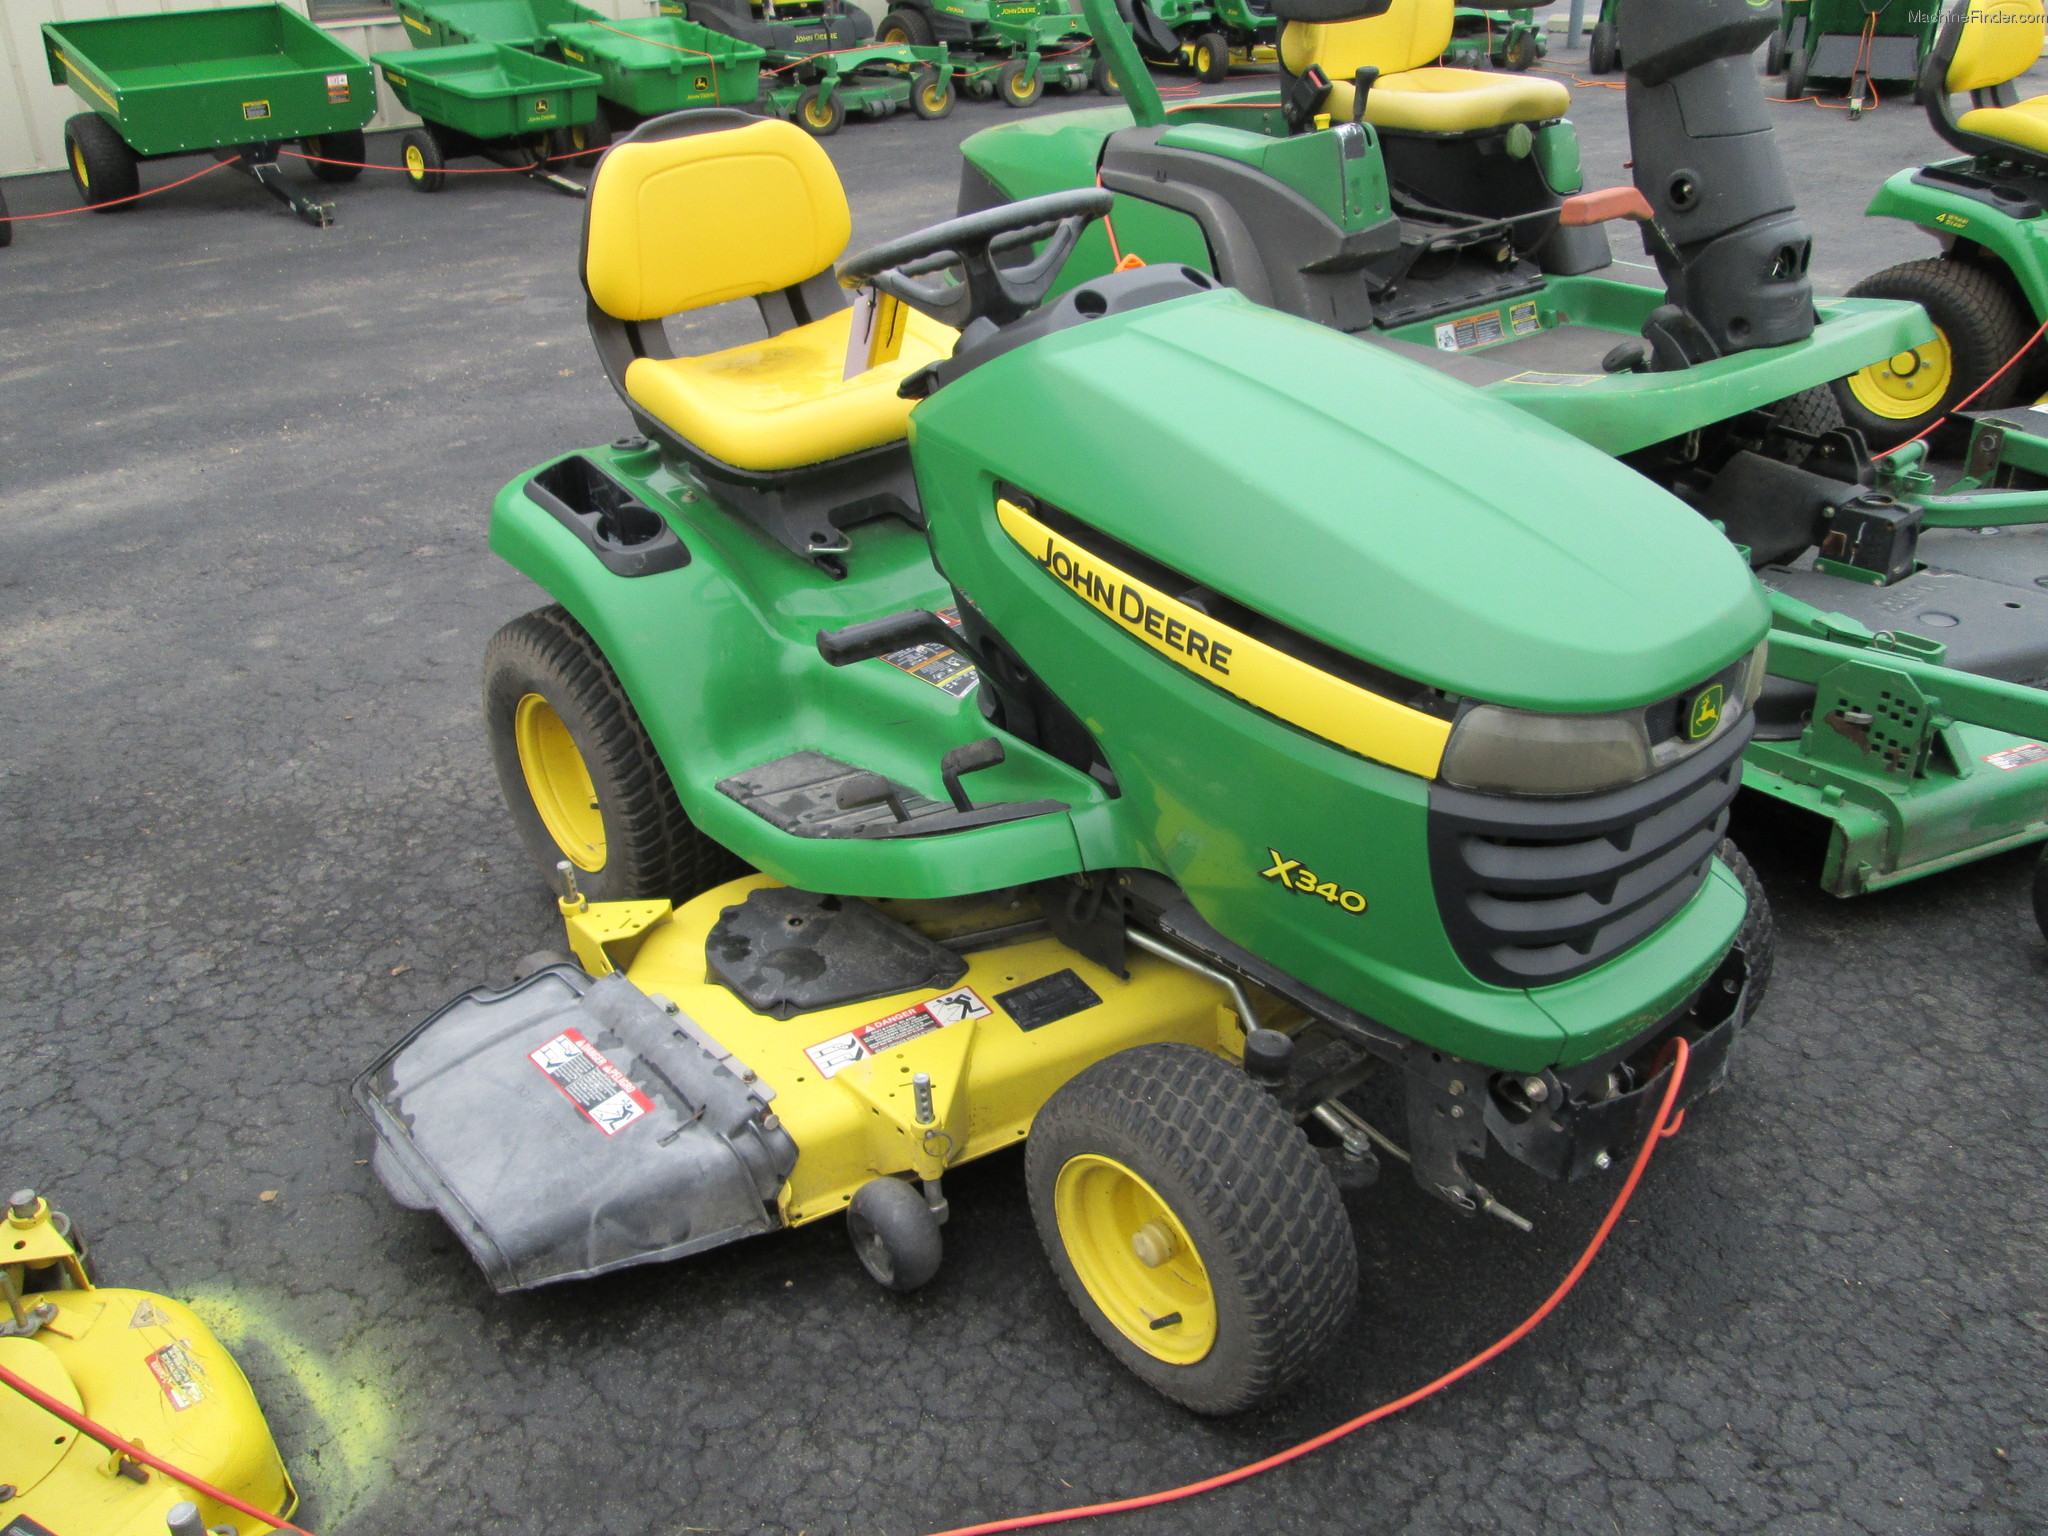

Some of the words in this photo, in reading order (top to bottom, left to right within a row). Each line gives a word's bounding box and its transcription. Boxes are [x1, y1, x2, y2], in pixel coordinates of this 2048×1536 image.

[794, 34, 813, 43] JOHN
[1935, 213, 1947, 223] 4
[1037, 537, 1114, 611] JOHN
[1119, 584, 1232, 675] DEERE
[1259, 847, 1368, 915] X340
[874, 1008, 917, 1028] DANGER
[580, 1043, 607, 1067] DANGER
[609, 1066, 636, 1093] PELIGRO
